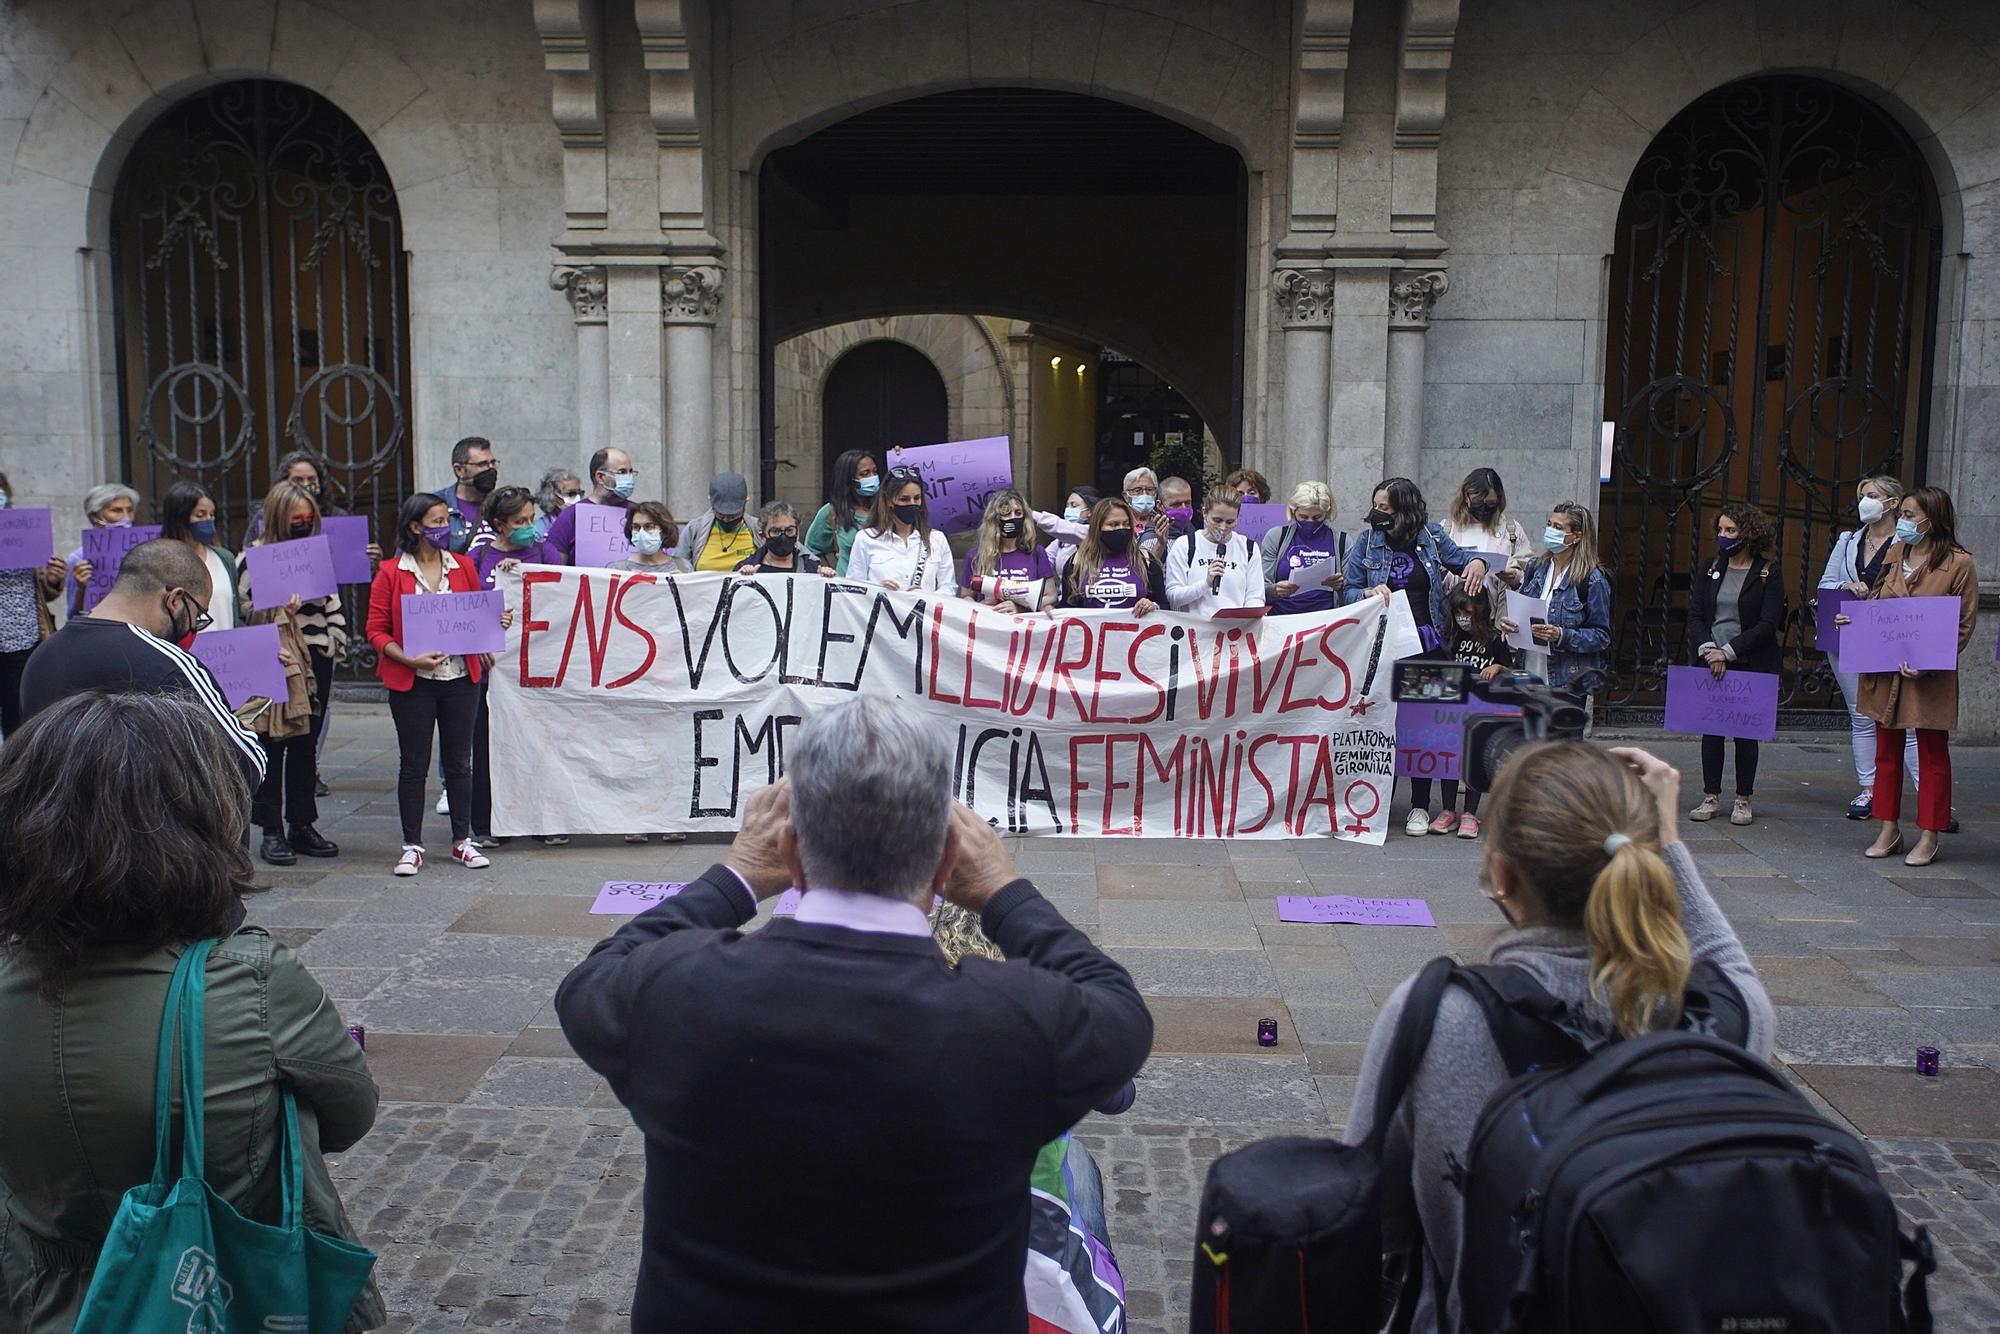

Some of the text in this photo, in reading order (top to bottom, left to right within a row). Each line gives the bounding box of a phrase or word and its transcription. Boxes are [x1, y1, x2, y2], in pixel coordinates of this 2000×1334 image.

[589, 515, 612, 534] EL
[89, 530, 113, 552] NI
[408, 593, 490, 615] LAURA PLAZA
[520, 571, 657, 689] ENS
[666, 576, 926, 694] VOLEM
[1694, 679, 1753, 695] WARDA
[1333, 730, 1396, 749] PLATAFORMA
